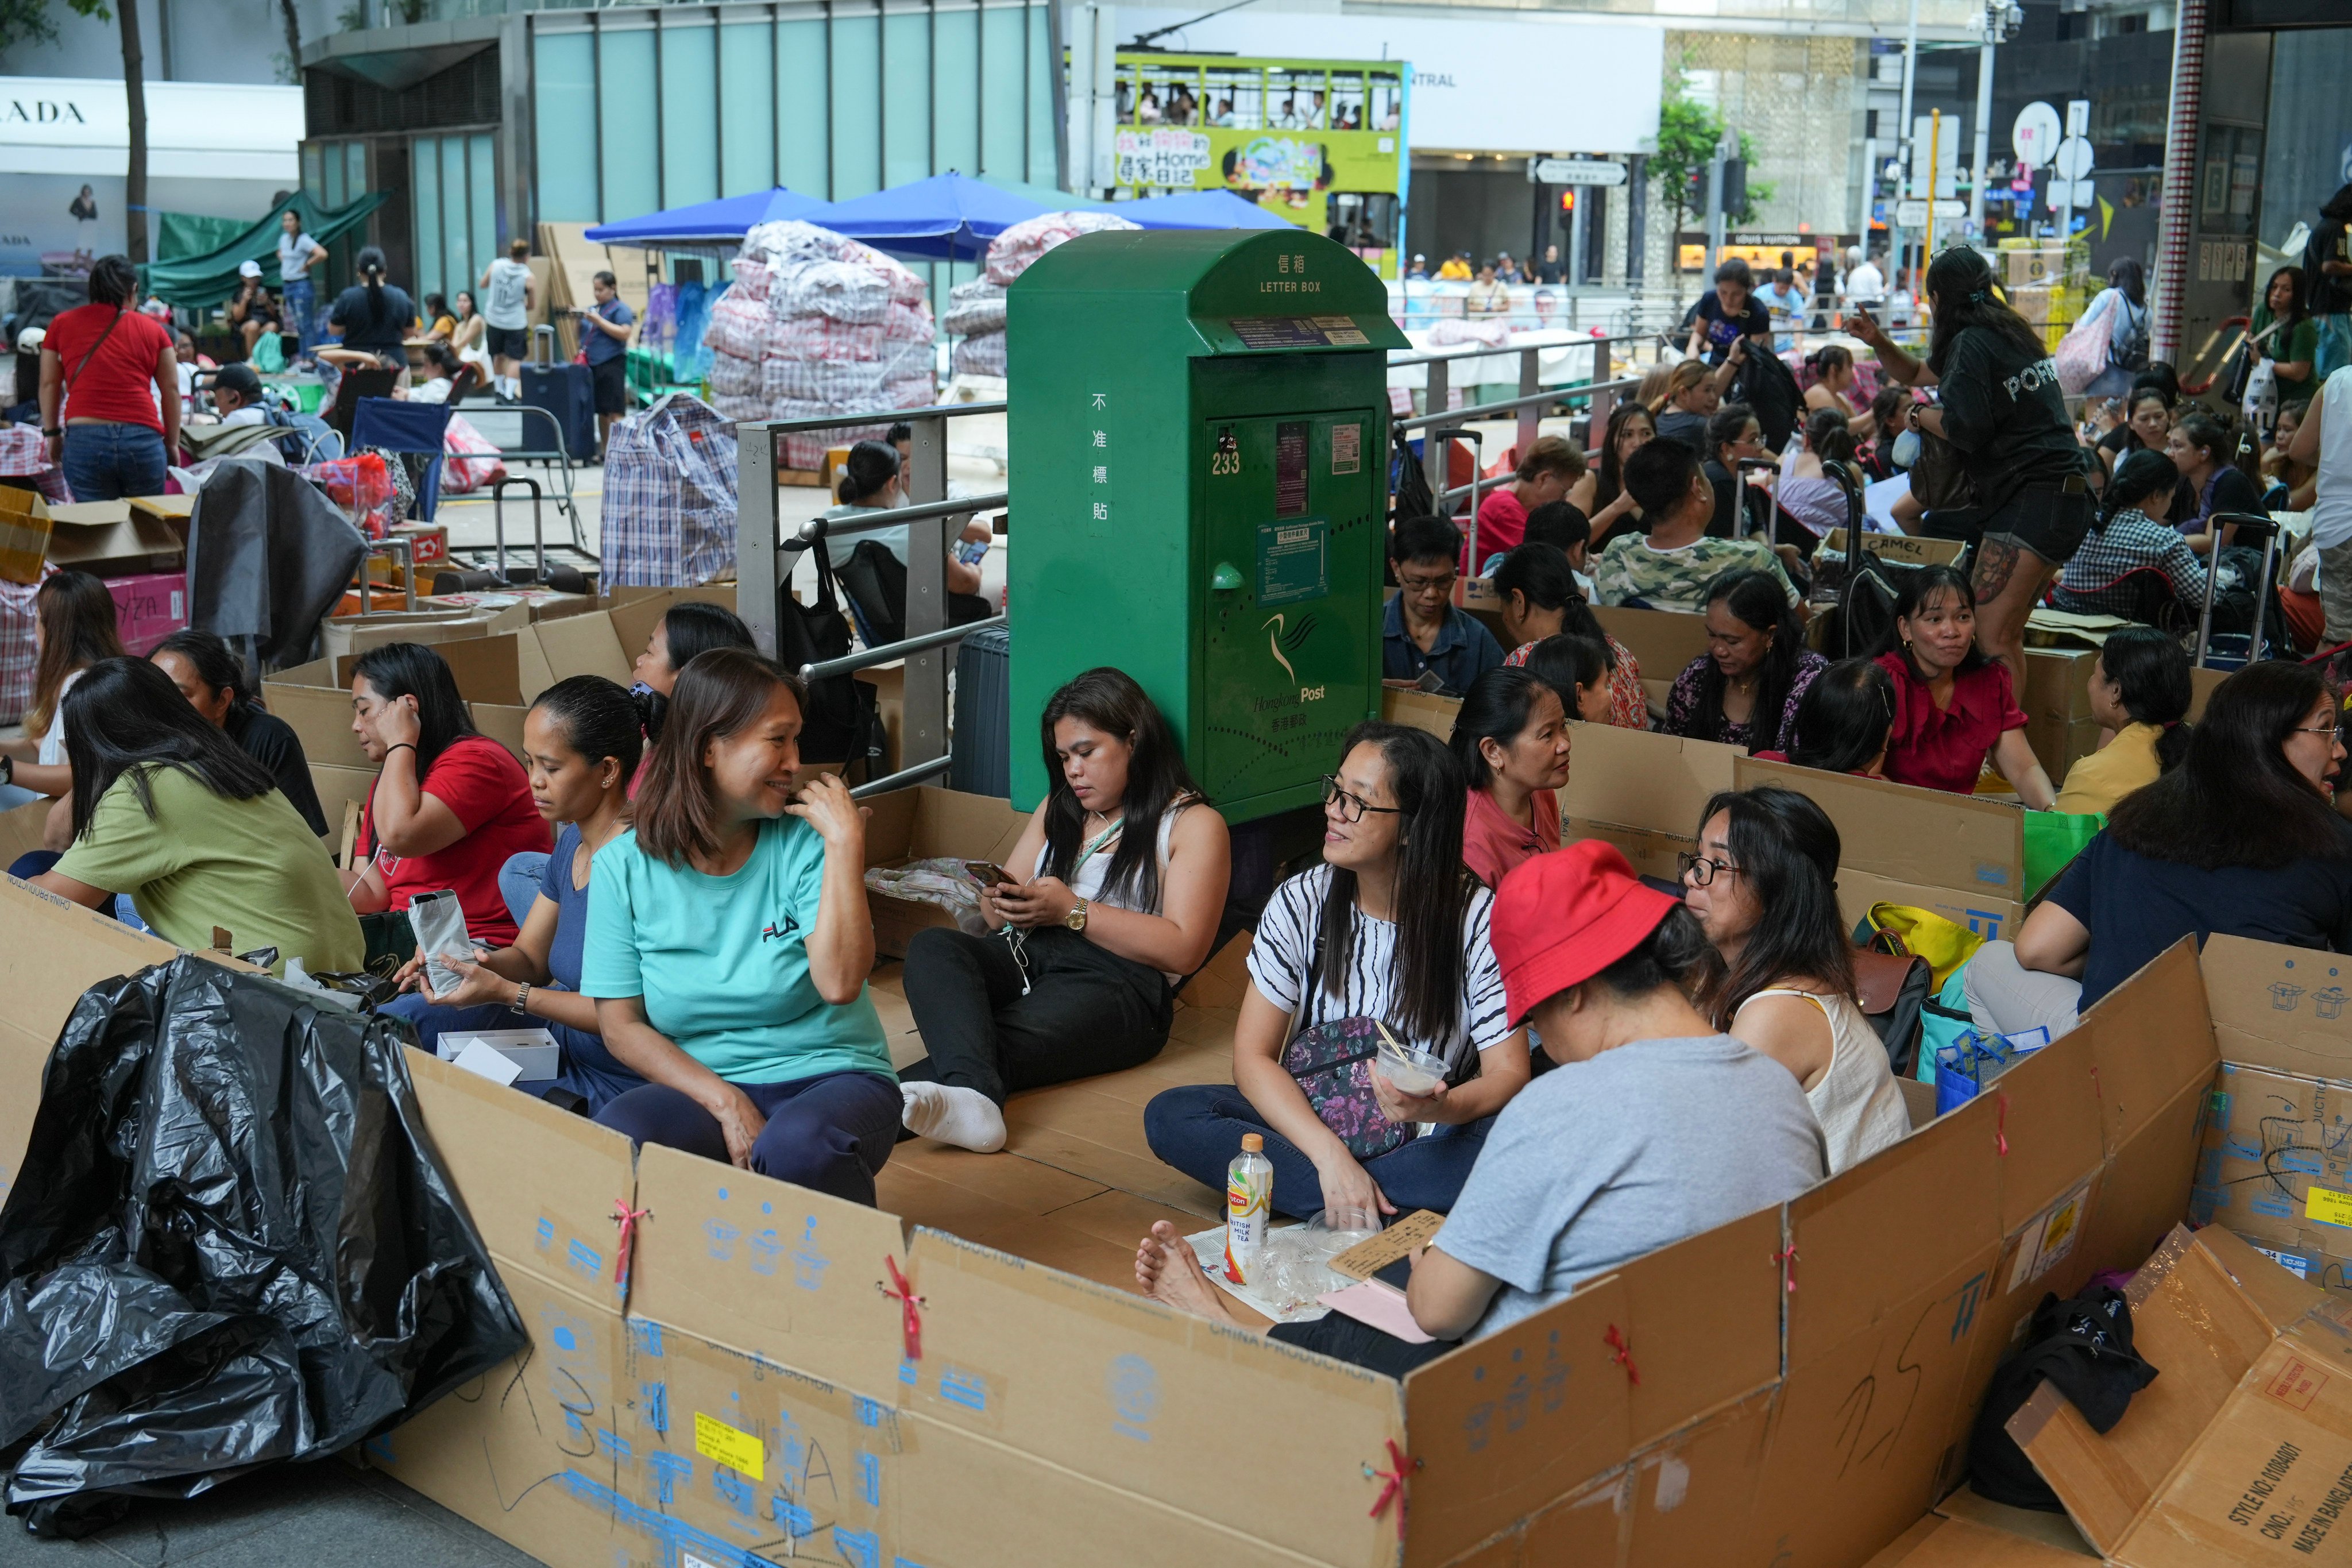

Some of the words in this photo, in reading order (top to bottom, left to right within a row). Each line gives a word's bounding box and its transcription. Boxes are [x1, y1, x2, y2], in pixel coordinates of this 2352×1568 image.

[0, 101, 86, 124] ADA
[1278, 254, 1304, 273] 信箱
[1261, 281, 1297, 292] LETTER
[1301, 281, 1321, 292] BOX
[1092, 393, 1107, 520] 不准標貼
[1212, 451, 1240, 475] 233
[1868, 539, 1922, 556] CAMEL
[1253, 693, 1300, 713] Hongkong
[1301, 685, 1325, 702] Post
[1272, 712, 1307, 733] 香港郵政
[1665, 832, 1697, 844] UCTION
[50, 895, 71, 911] CHINA
[1229, 1194, 1245, 1205] ipton
[2228, 1492, 2265, 1526] STYLE
[2261, 1441, 2303, 1482] 01084001
[2291, 1523, 2326, 1555] MADE
[2311, 1513, 2335, 1534] IN
